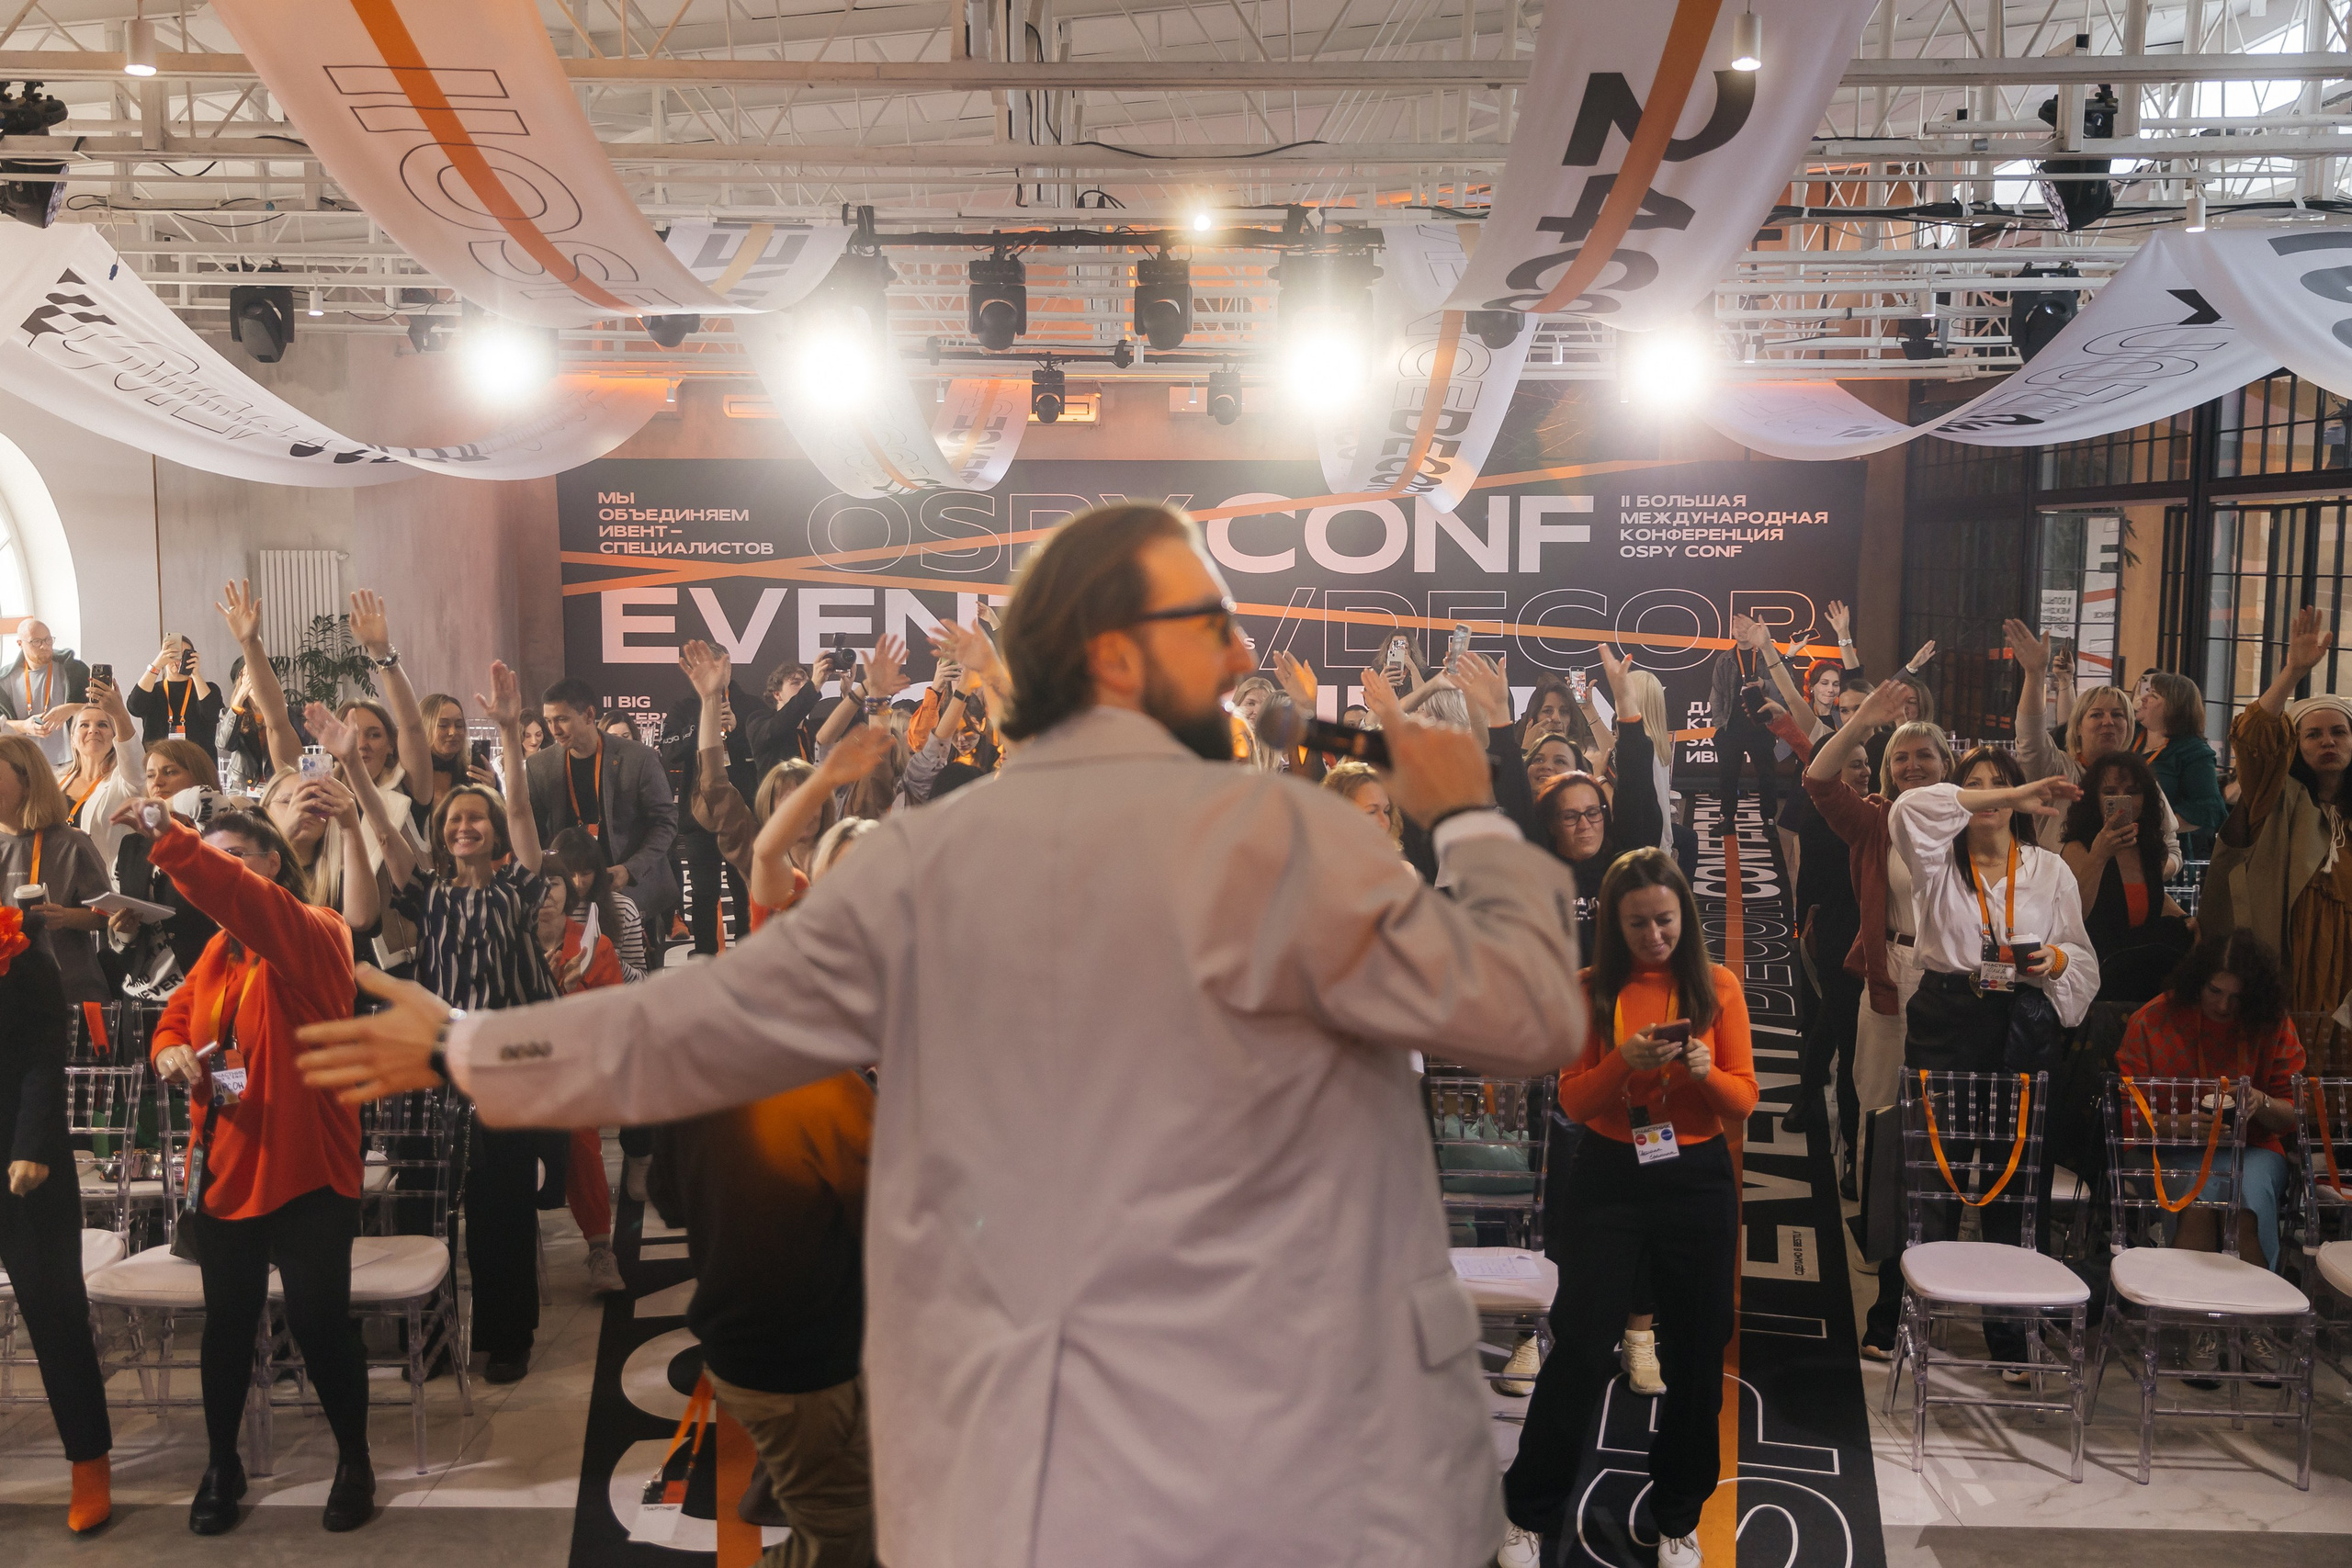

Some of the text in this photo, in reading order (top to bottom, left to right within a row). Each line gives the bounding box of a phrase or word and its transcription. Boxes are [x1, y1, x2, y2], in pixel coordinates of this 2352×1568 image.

[598, 492, 635, 504] МЫ
[1621, 494, 1747, 507] II БОЛЬШАЯ
[598, 508, 750, 524] ОБЪЕДИНЯЕМ
[1620, 511, 1828, 526] МЕЖДУНАРОДНАЯ
[807, 491, 1594, 574] OSP CONF
[1620, 528, 1784, 543] КОНФЕРЕНЦИЯ
[600, 541, 775, 556] СПЕЦИАЛИСТОВ
[1620, 545, 1743, 558] OSPY CONF
[601, 586, 1010, 665] EVEN
[603, 696, 651, 708] II BIG
